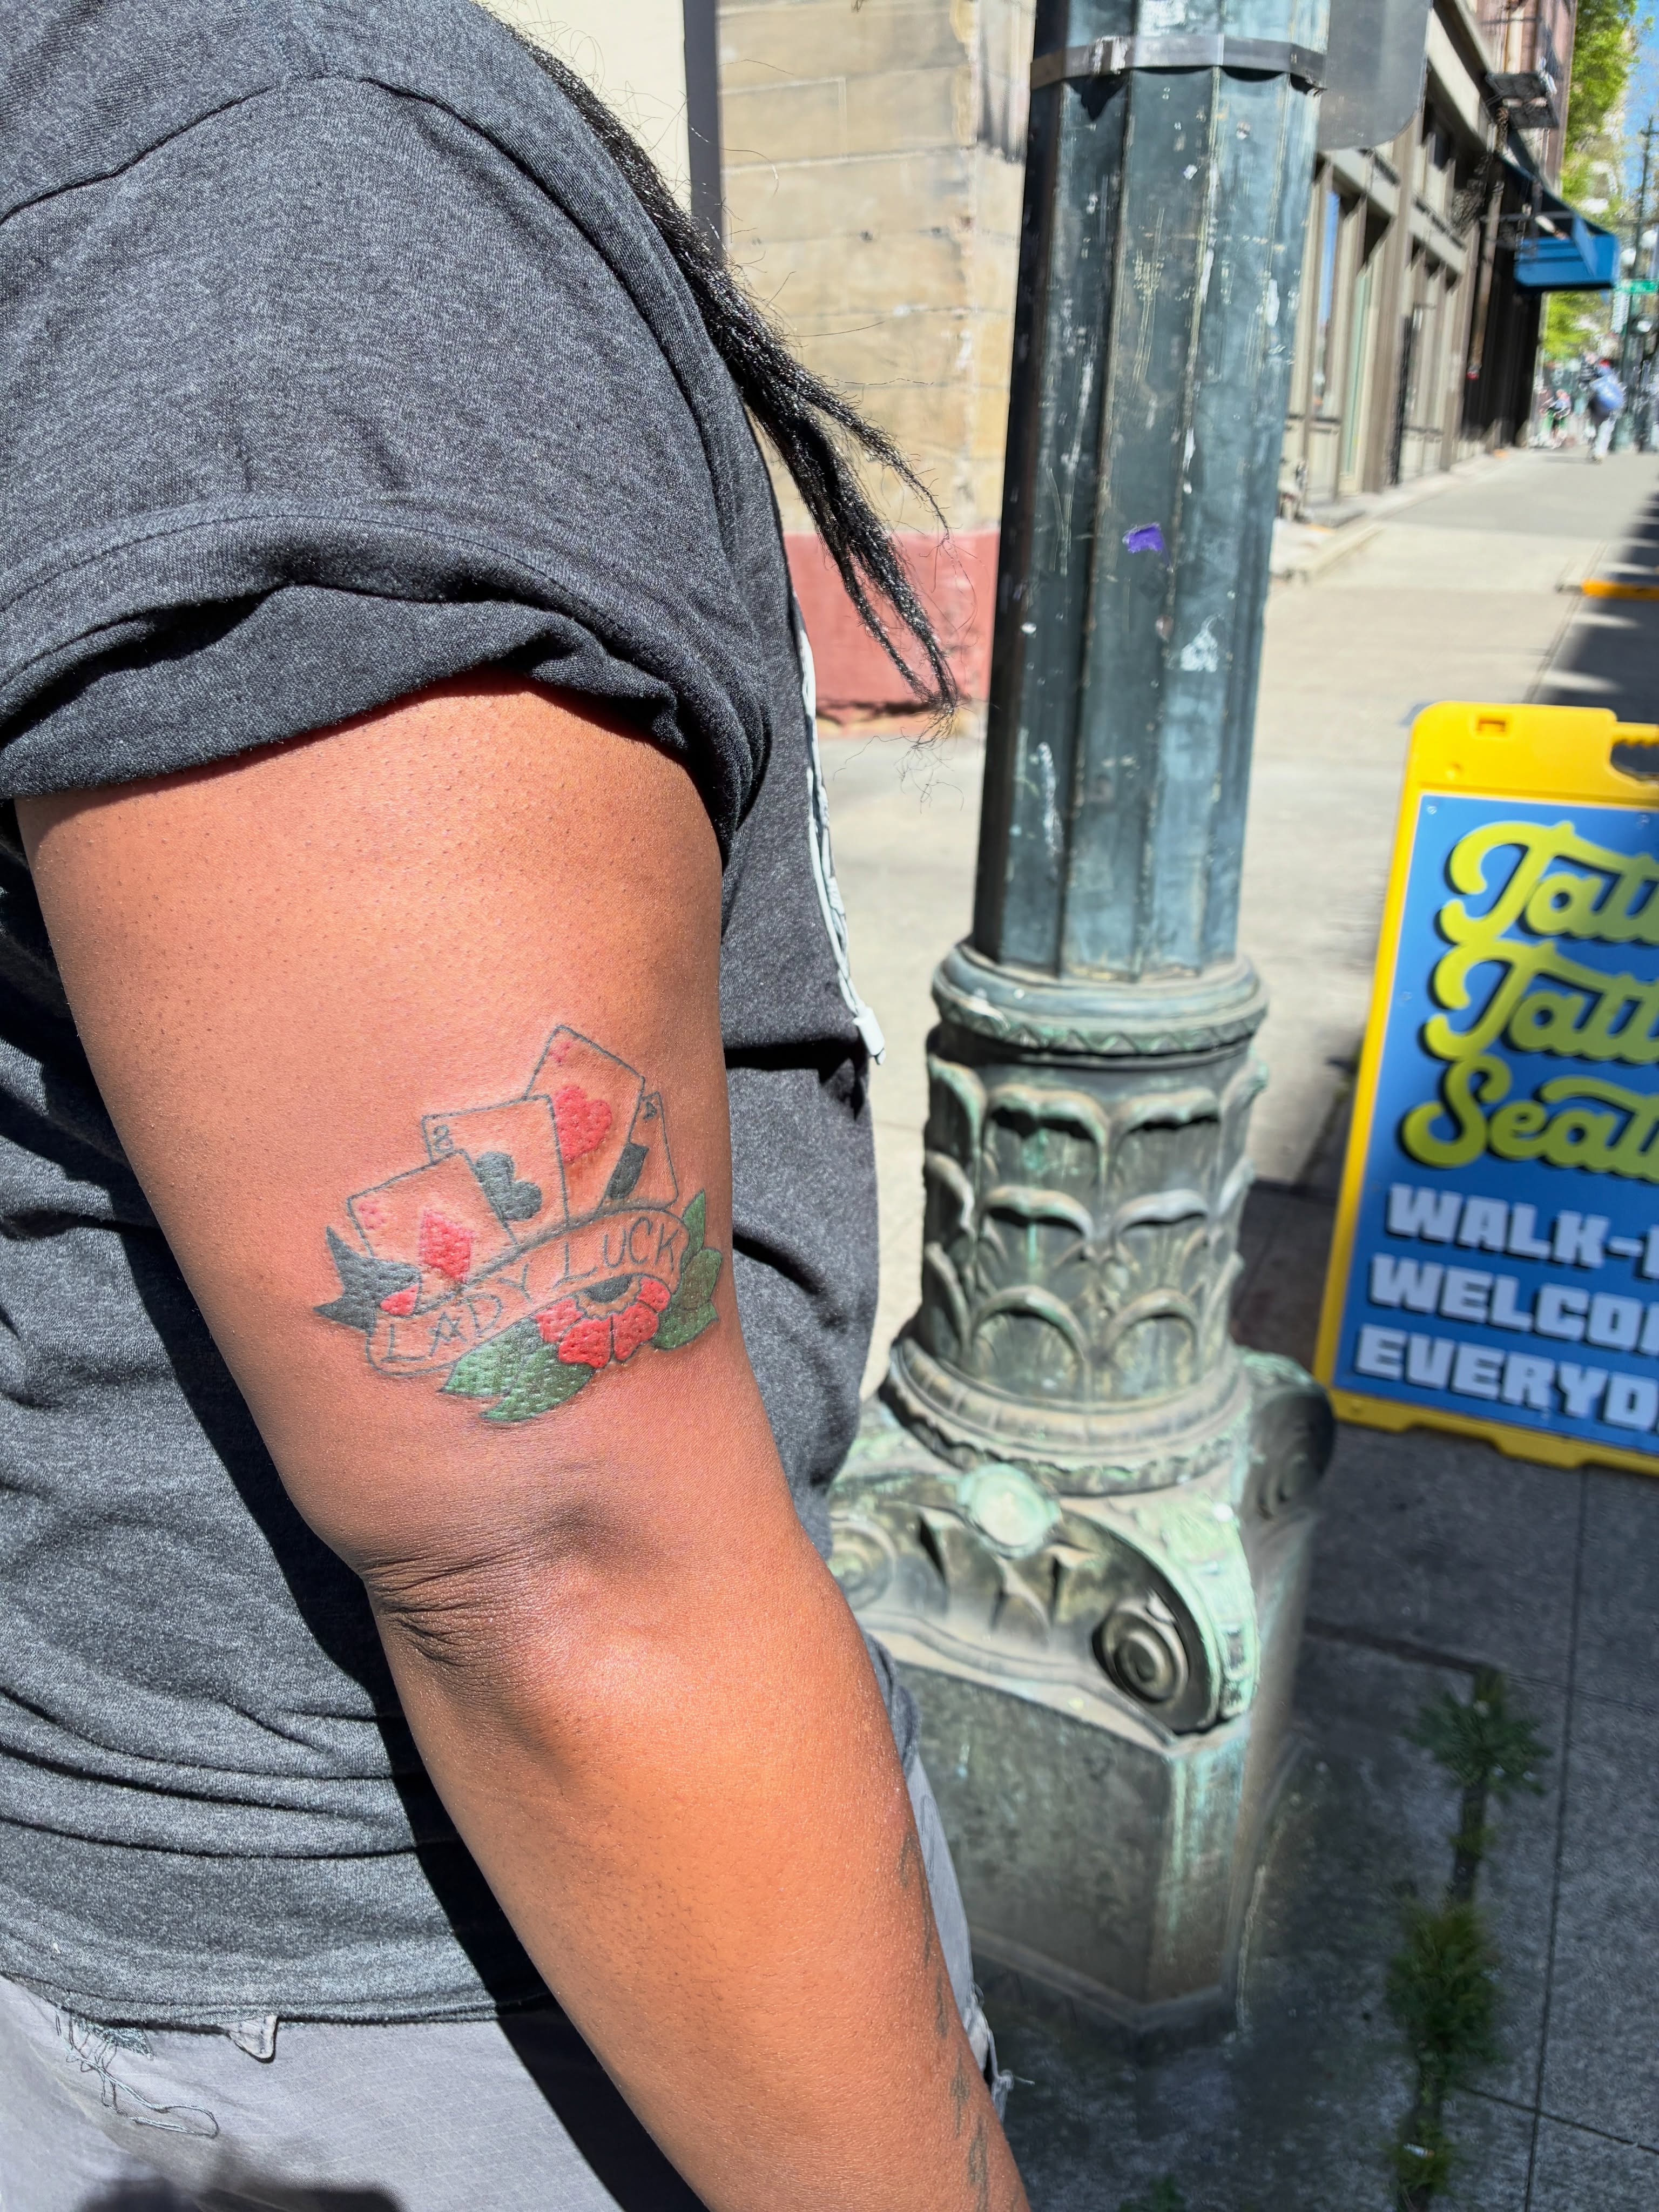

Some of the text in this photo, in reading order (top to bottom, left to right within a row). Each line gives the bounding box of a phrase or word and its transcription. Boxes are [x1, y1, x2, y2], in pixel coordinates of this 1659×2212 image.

[434, 1123, 455, 1155] 8
[1404, 1054, 1659, 1184] Seat
[380, 1217, 678, 1362] LADY LUCK
[1368, 1253, 1659, 1357] WELCO
